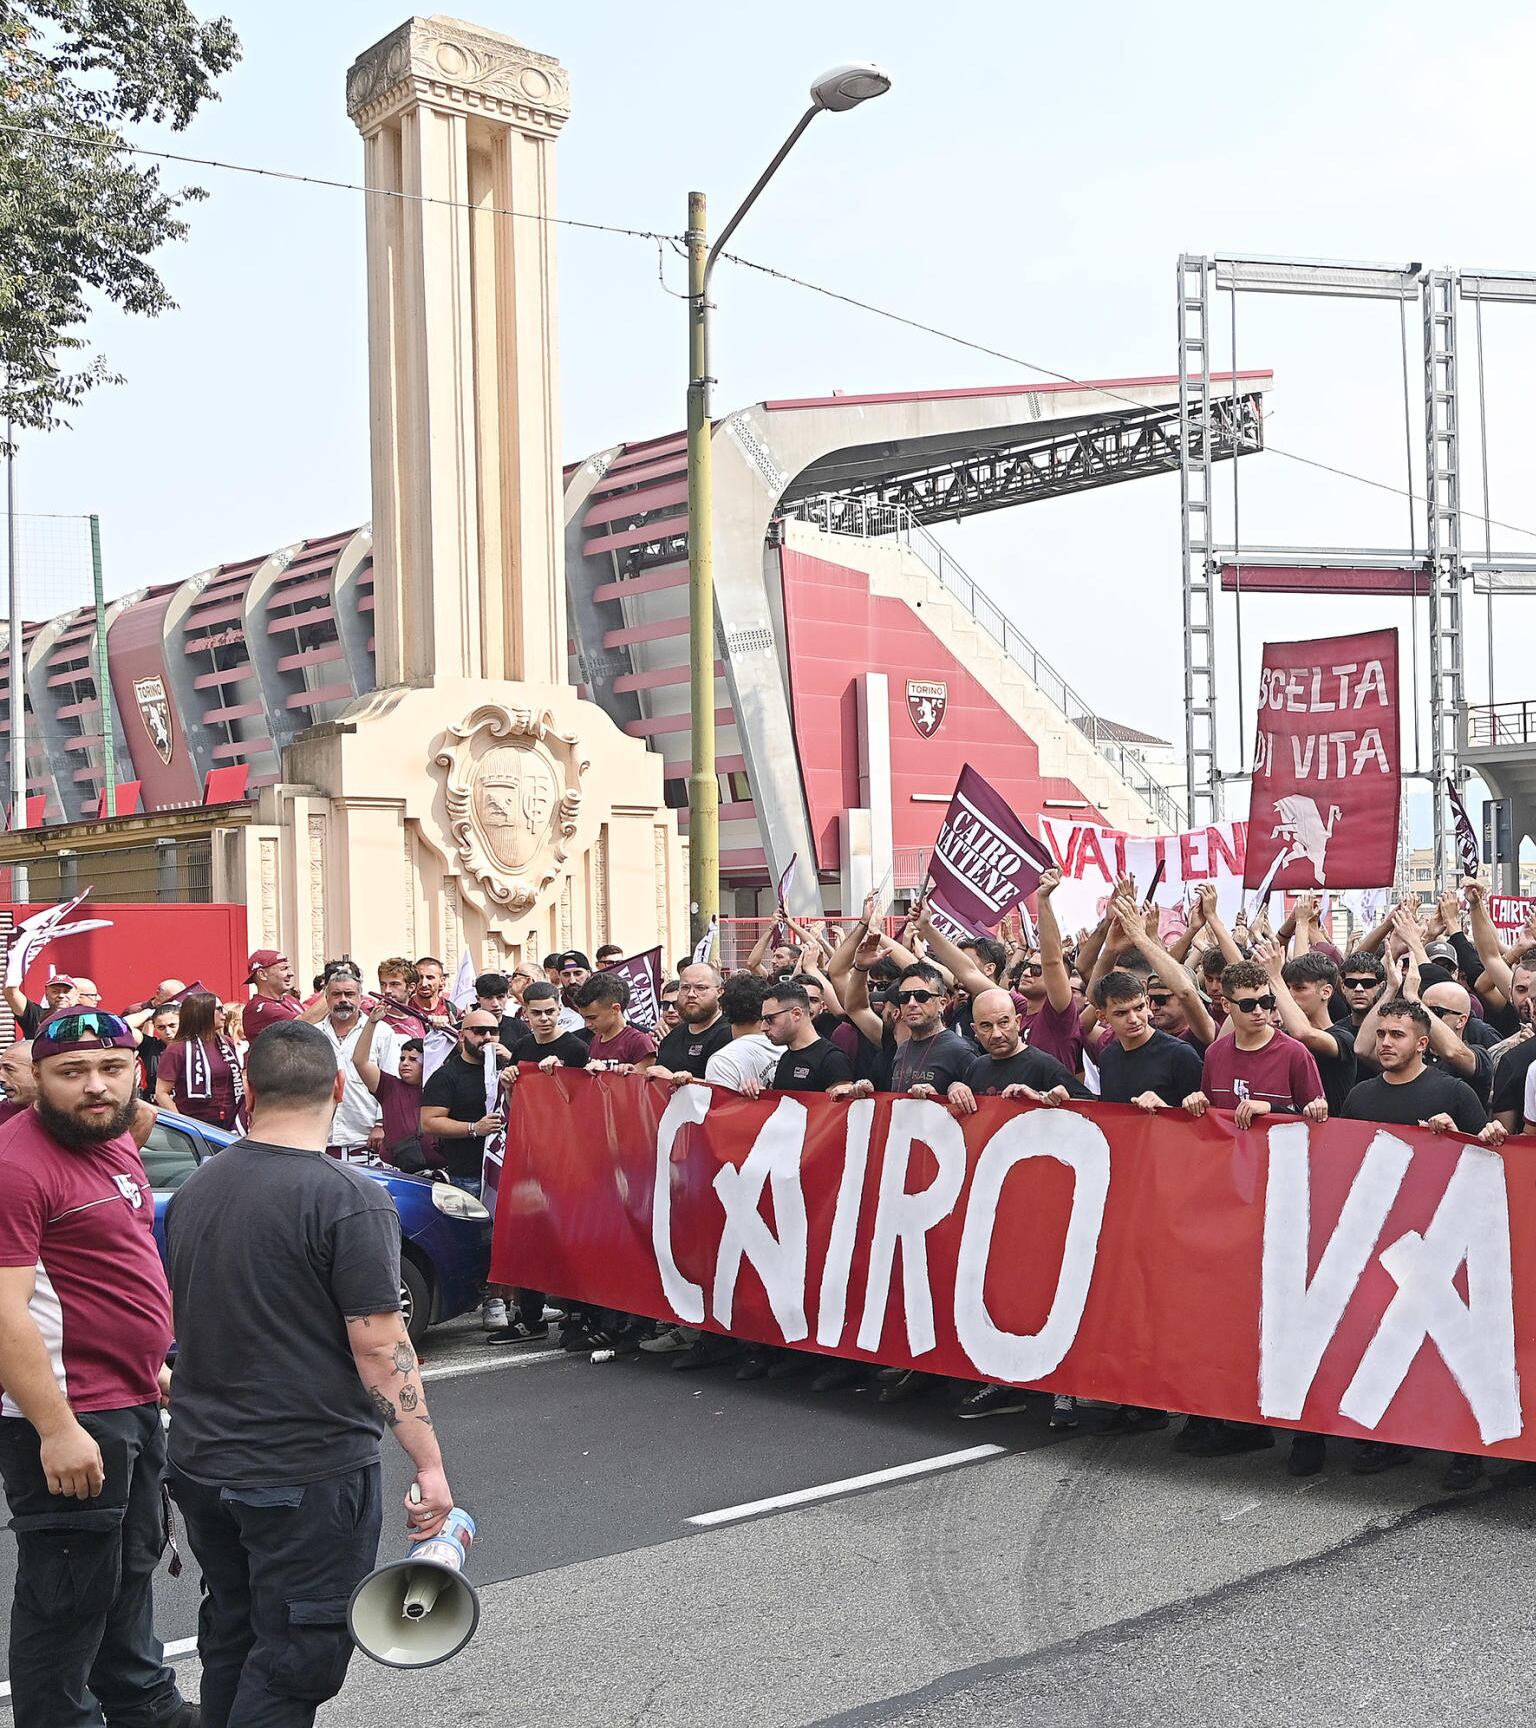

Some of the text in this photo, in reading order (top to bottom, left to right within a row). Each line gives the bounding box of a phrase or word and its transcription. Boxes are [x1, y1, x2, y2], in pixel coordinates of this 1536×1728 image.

[137, 683, 162, 699] TORINO
[911, 685, 943, 696] TORINO
[931, 699, 944, 708] FC
[1258, 660, 1389, 713] SCELTA
[1290, 728, 1390, 779] VITA
[938, 820, 1020, 907] VATTENE
[952, 810, 1022, 876] CAIRO
[1042, 820, 1249, 883] VATTEN
[652, 1086, 1111, 1382] CAIRO
